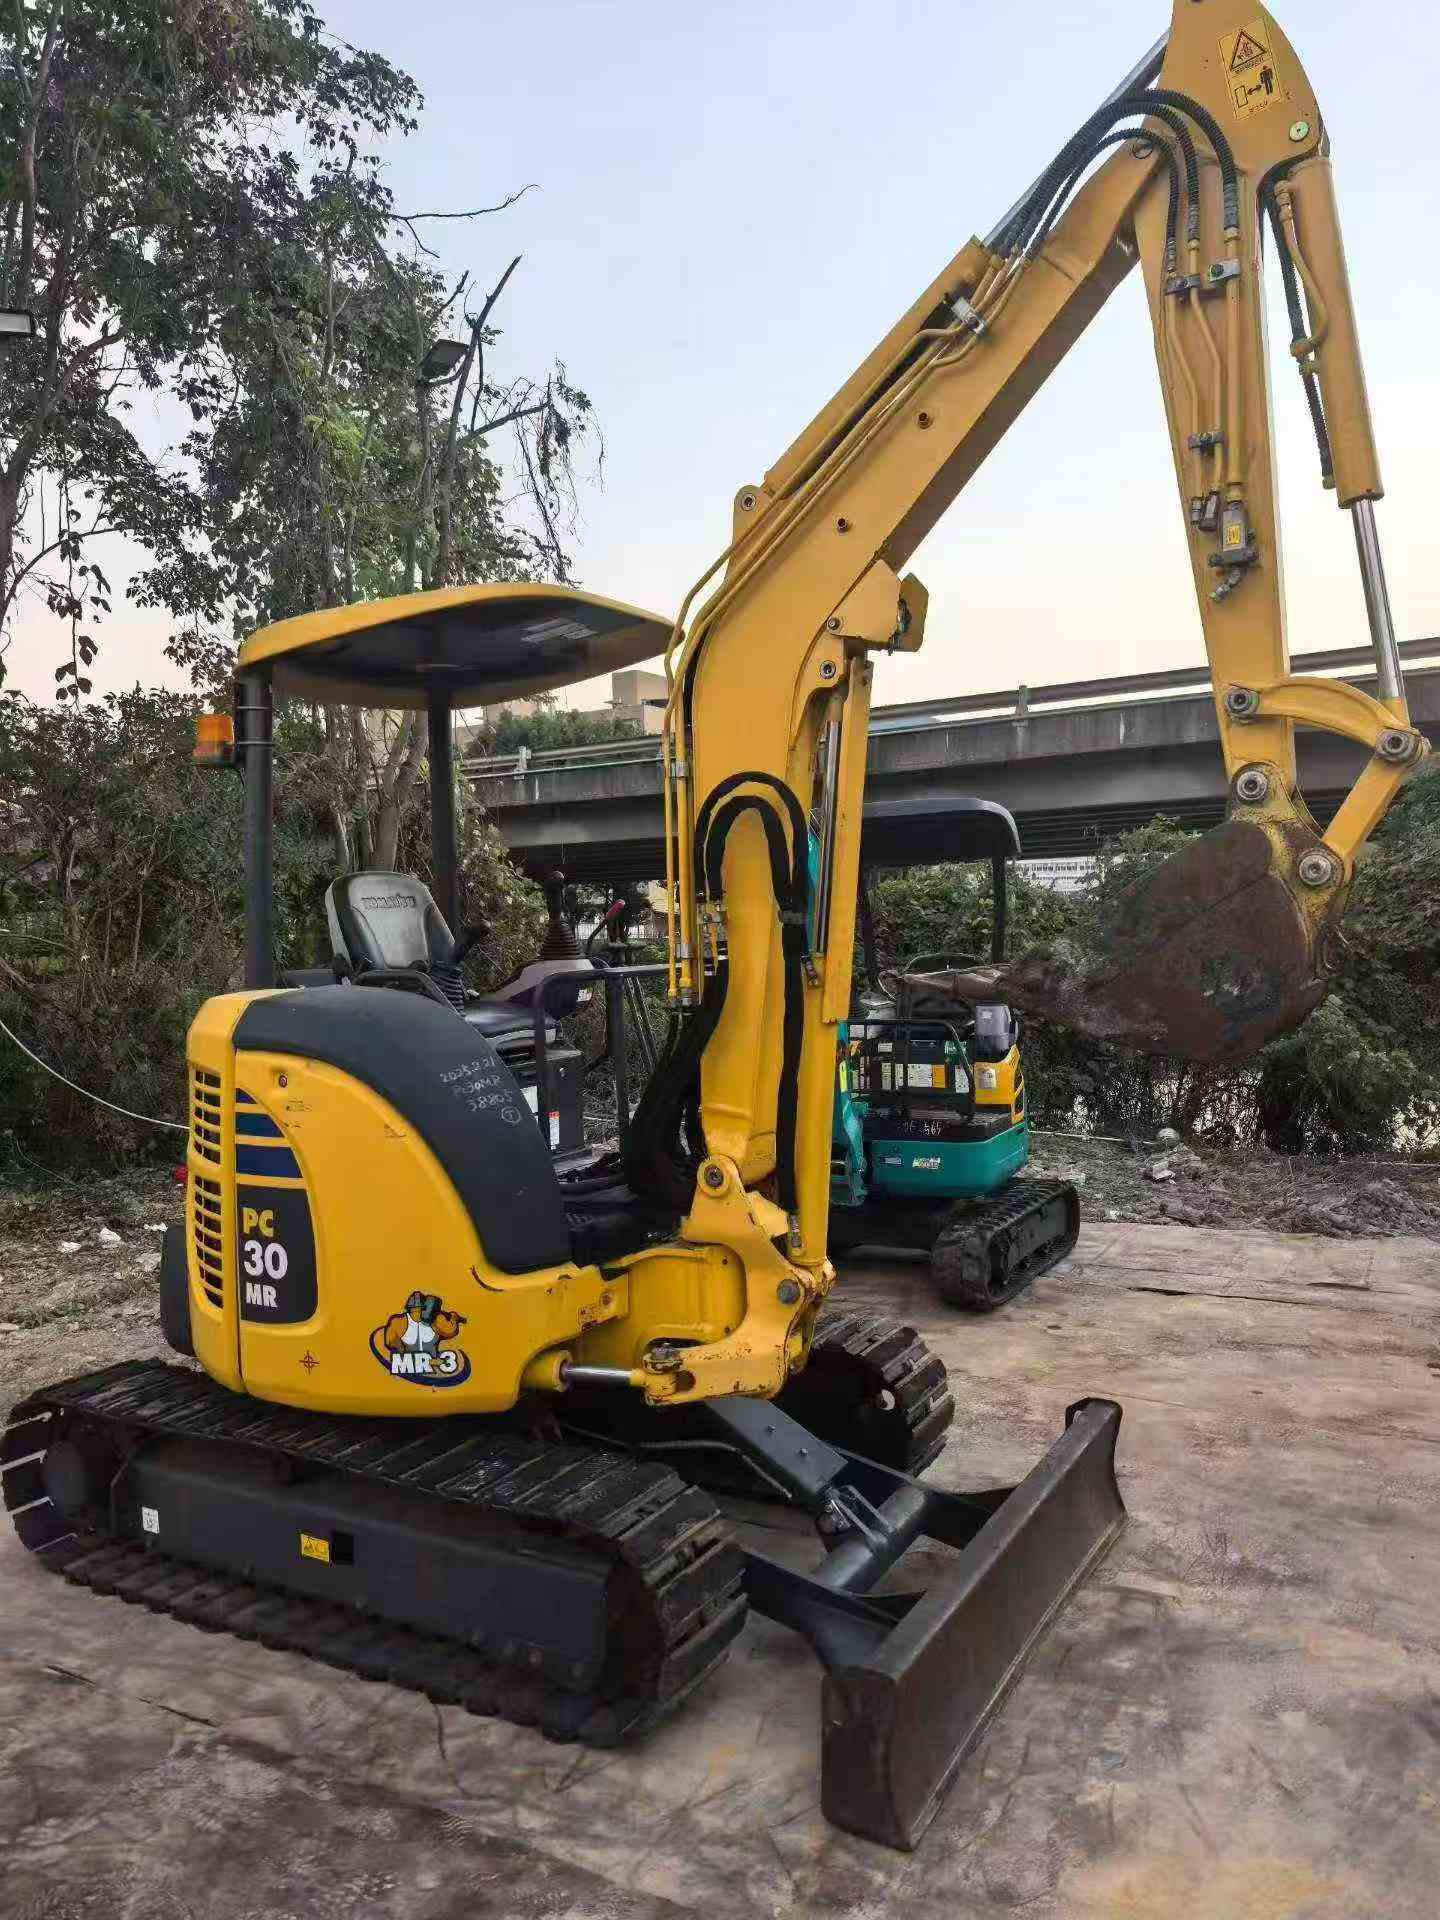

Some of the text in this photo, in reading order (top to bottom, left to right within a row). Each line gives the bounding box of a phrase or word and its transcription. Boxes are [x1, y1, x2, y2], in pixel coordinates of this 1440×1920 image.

[243, 1207, 274, 1237] PC
[243, 1240, 288, 1279] 30
[246, 1281, 277, 1307] MR
[391, 1350, 457, 1374] MR-3
